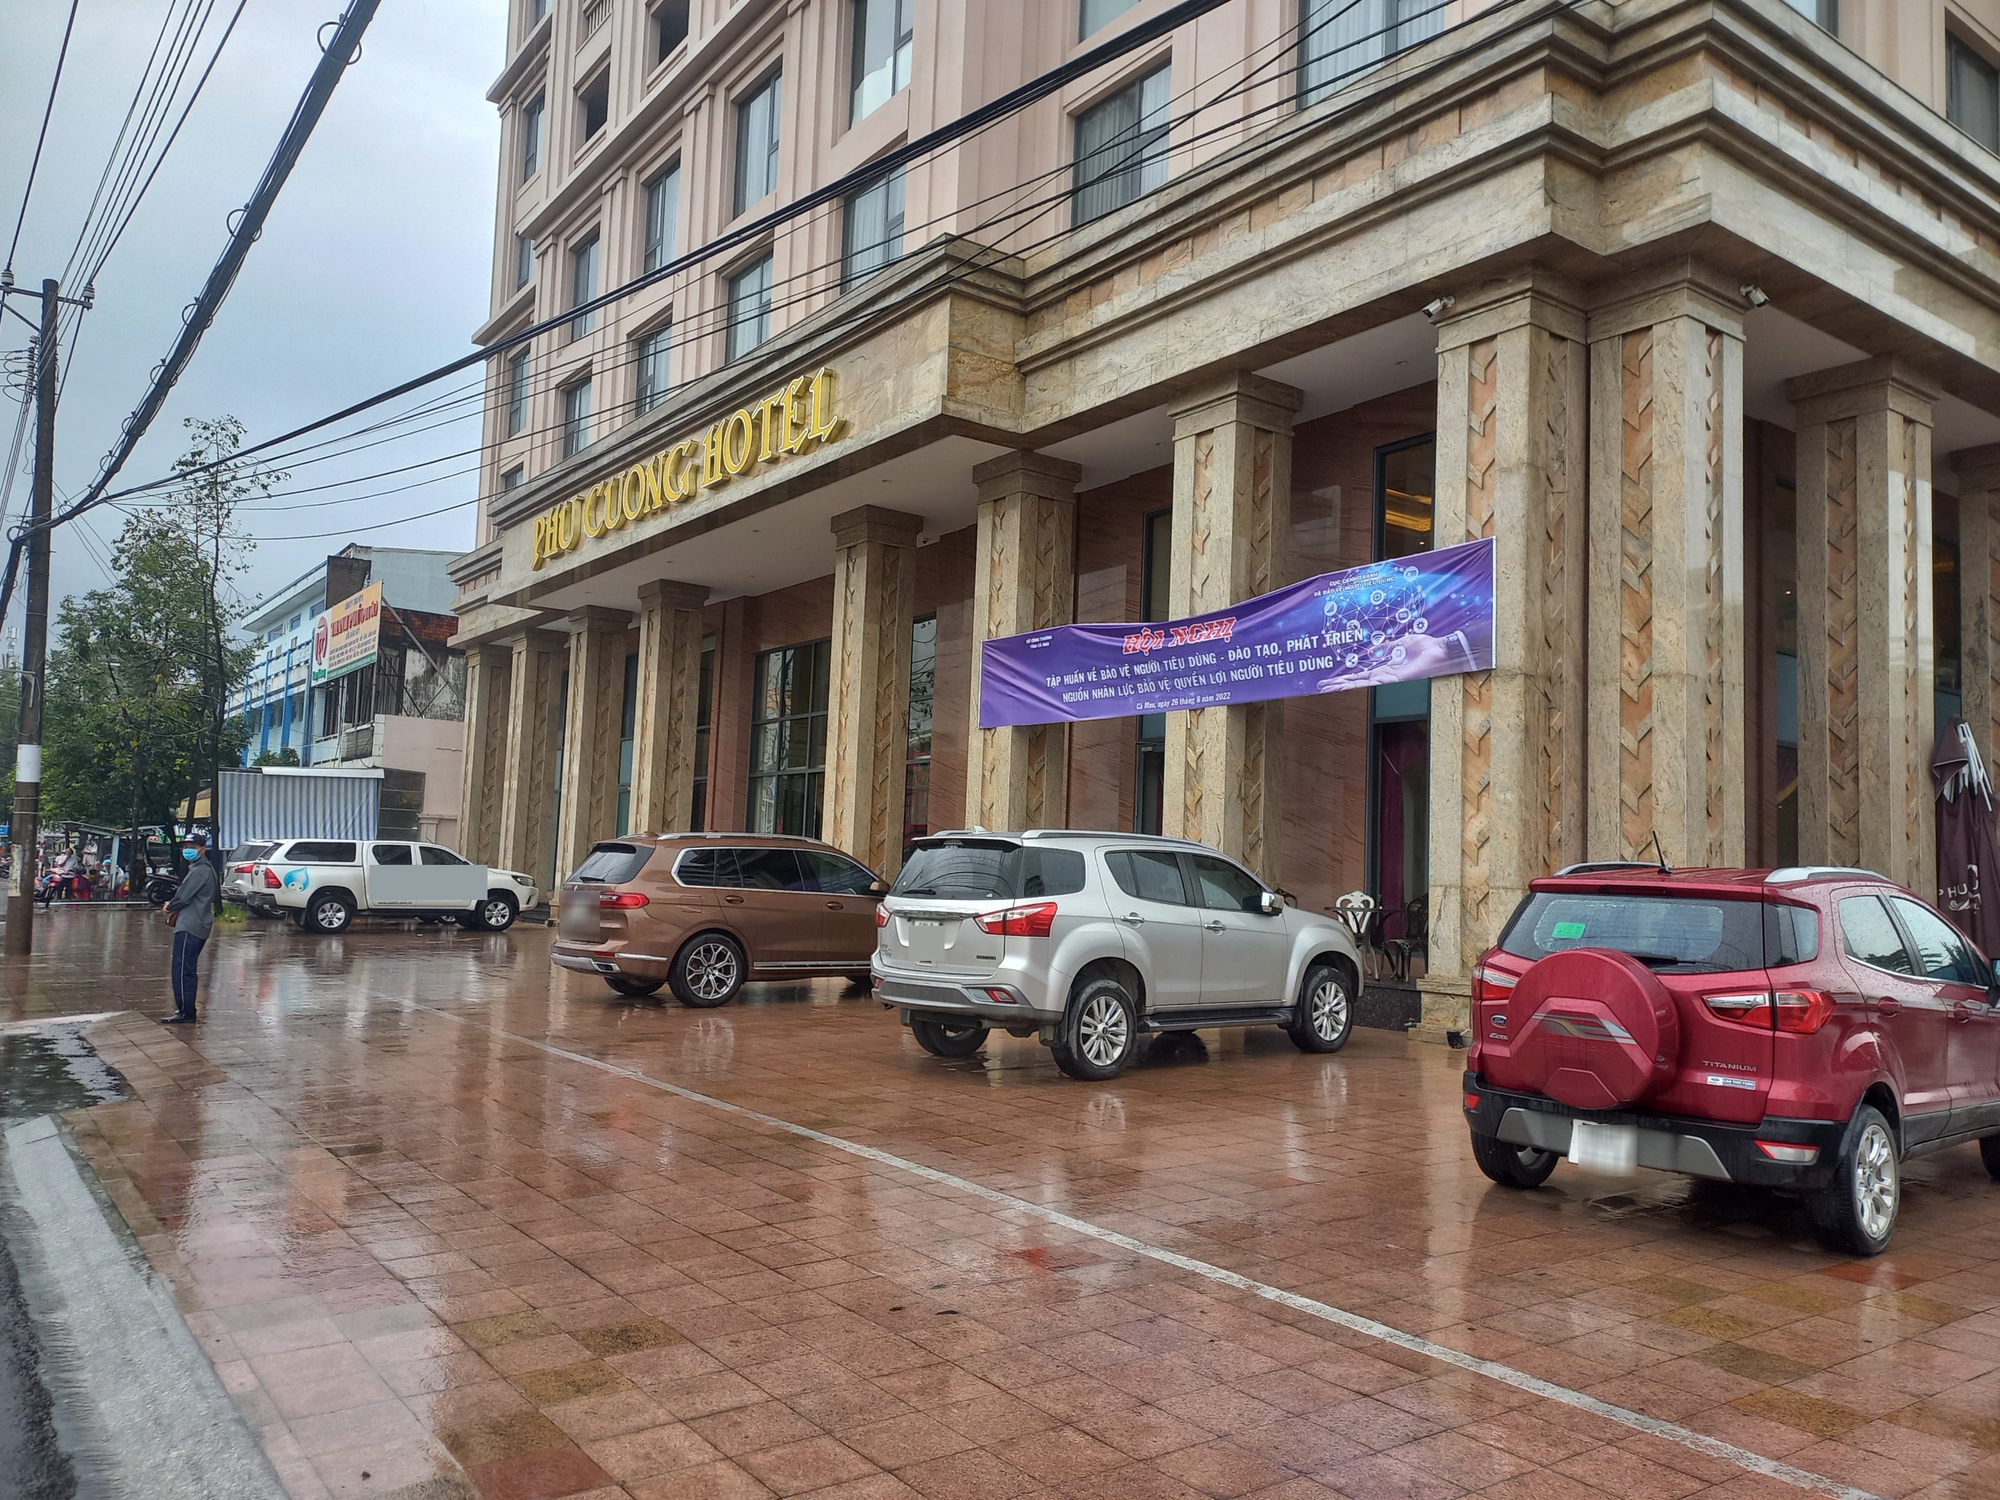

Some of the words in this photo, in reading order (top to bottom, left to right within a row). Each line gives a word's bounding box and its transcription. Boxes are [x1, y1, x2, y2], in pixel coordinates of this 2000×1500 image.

[531, 494, 583, 571] PHU
[583, 439, 698, 538] CUONG
[701, 366, 843, 489] HOTEL
[1122, 627, 1165, 656] HỘI
[1168, 616, 1237, 643] NGHỊ
[1046, 674, 1062, 689] TẬP
[1063, 669, 1085, 686] HUẤN
[1100, 664, 1118, 680] BẢO
[1119, 663, 1131, 679] VỆ
[1133, 660, 1160, 676] NGƯỜI
[1163, 655, 1185, 672] TIÊU
[1188, 652, 1217, 668] DÙNG
[1228, 645, 1252, 661] ĐÀO
[1255, 642, 1282, 658] TẠO,
[1287, 634, 1319, 653] PHÁT
[1062, 686, 1089, 703] NGUỒN
[1092, 685, 1115, 700] NHÂN
[1118, 683, 1135, 698] LỰC
[1138, 678, 1156, 694] BẢO
[1158, 677, 1171, 692] VỆ
[1174, 671, 1207, 691] QUYỀN
[1209, 669, 1227, 686] LỢI
[1230, 663, 1264, 682] NGƯỜI
[1267, 660, 1294, 677] TIÊU
[1299, 654, 1334, 673] DÙNG
[1171, 698, 1179, 706] 26
[1215, 692, 1231, 701] 2022
[1702, 1060, 1757, 1072] TITANIUM
